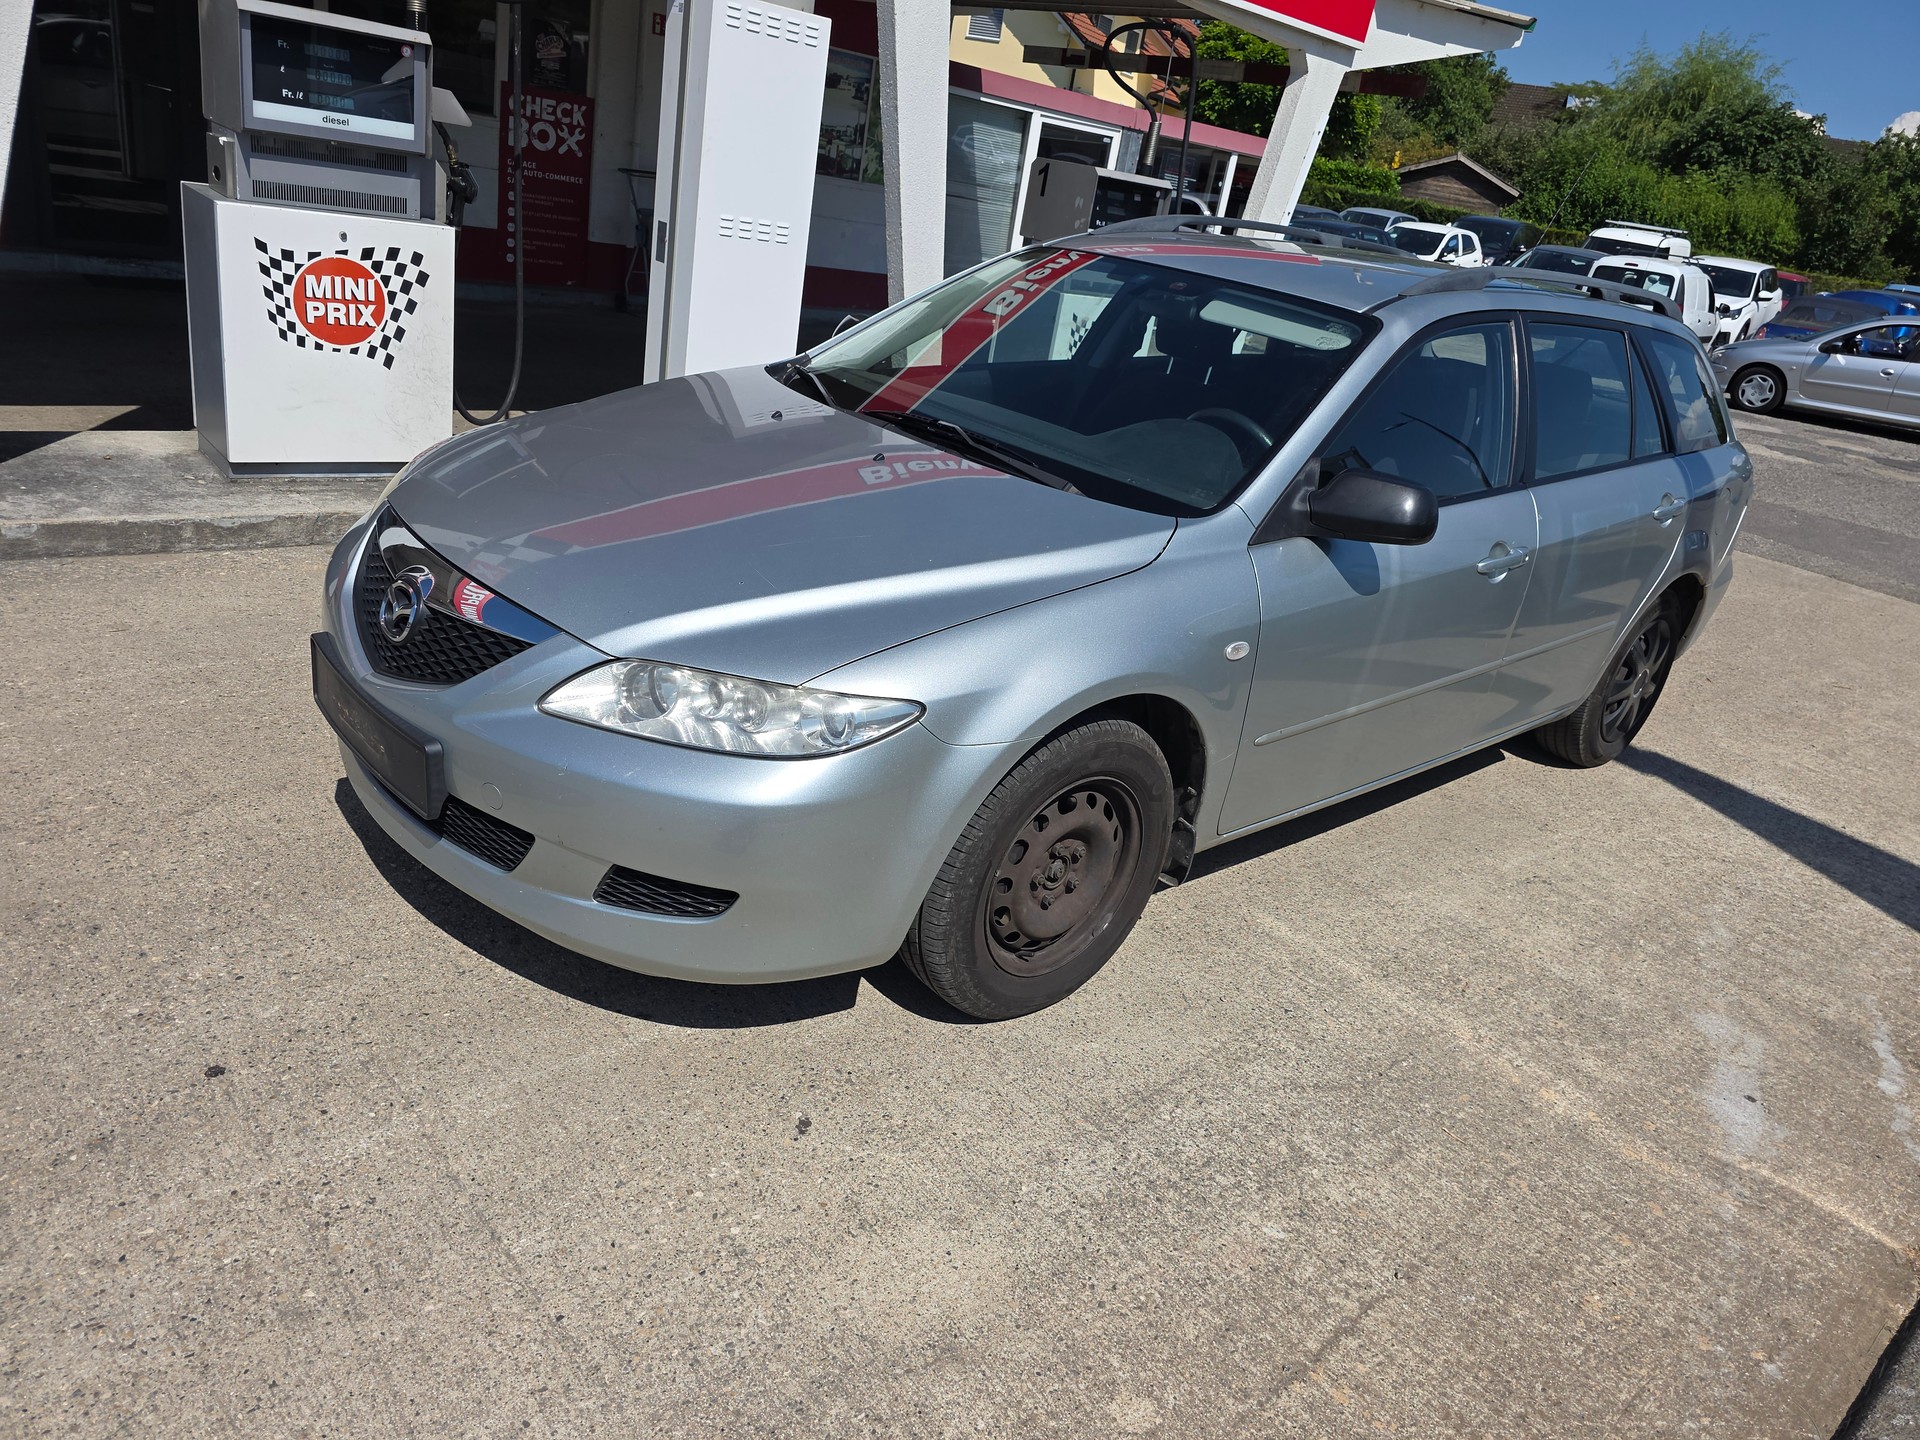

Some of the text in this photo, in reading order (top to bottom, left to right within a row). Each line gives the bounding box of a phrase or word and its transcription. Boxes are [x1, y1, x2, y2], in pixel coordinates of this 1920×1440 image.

[277, 39, 289, 49] Fr.
[322, 115, 350, 127] diesel
[508, 94, 587, 126] CHECK
[523, 169, 584, 185] AUTO-COMMERCE
[1038, 163, 1050, 197] 1
[304, 273, 377, 301] MINI
[305, 301, 377, 328] PRIX
